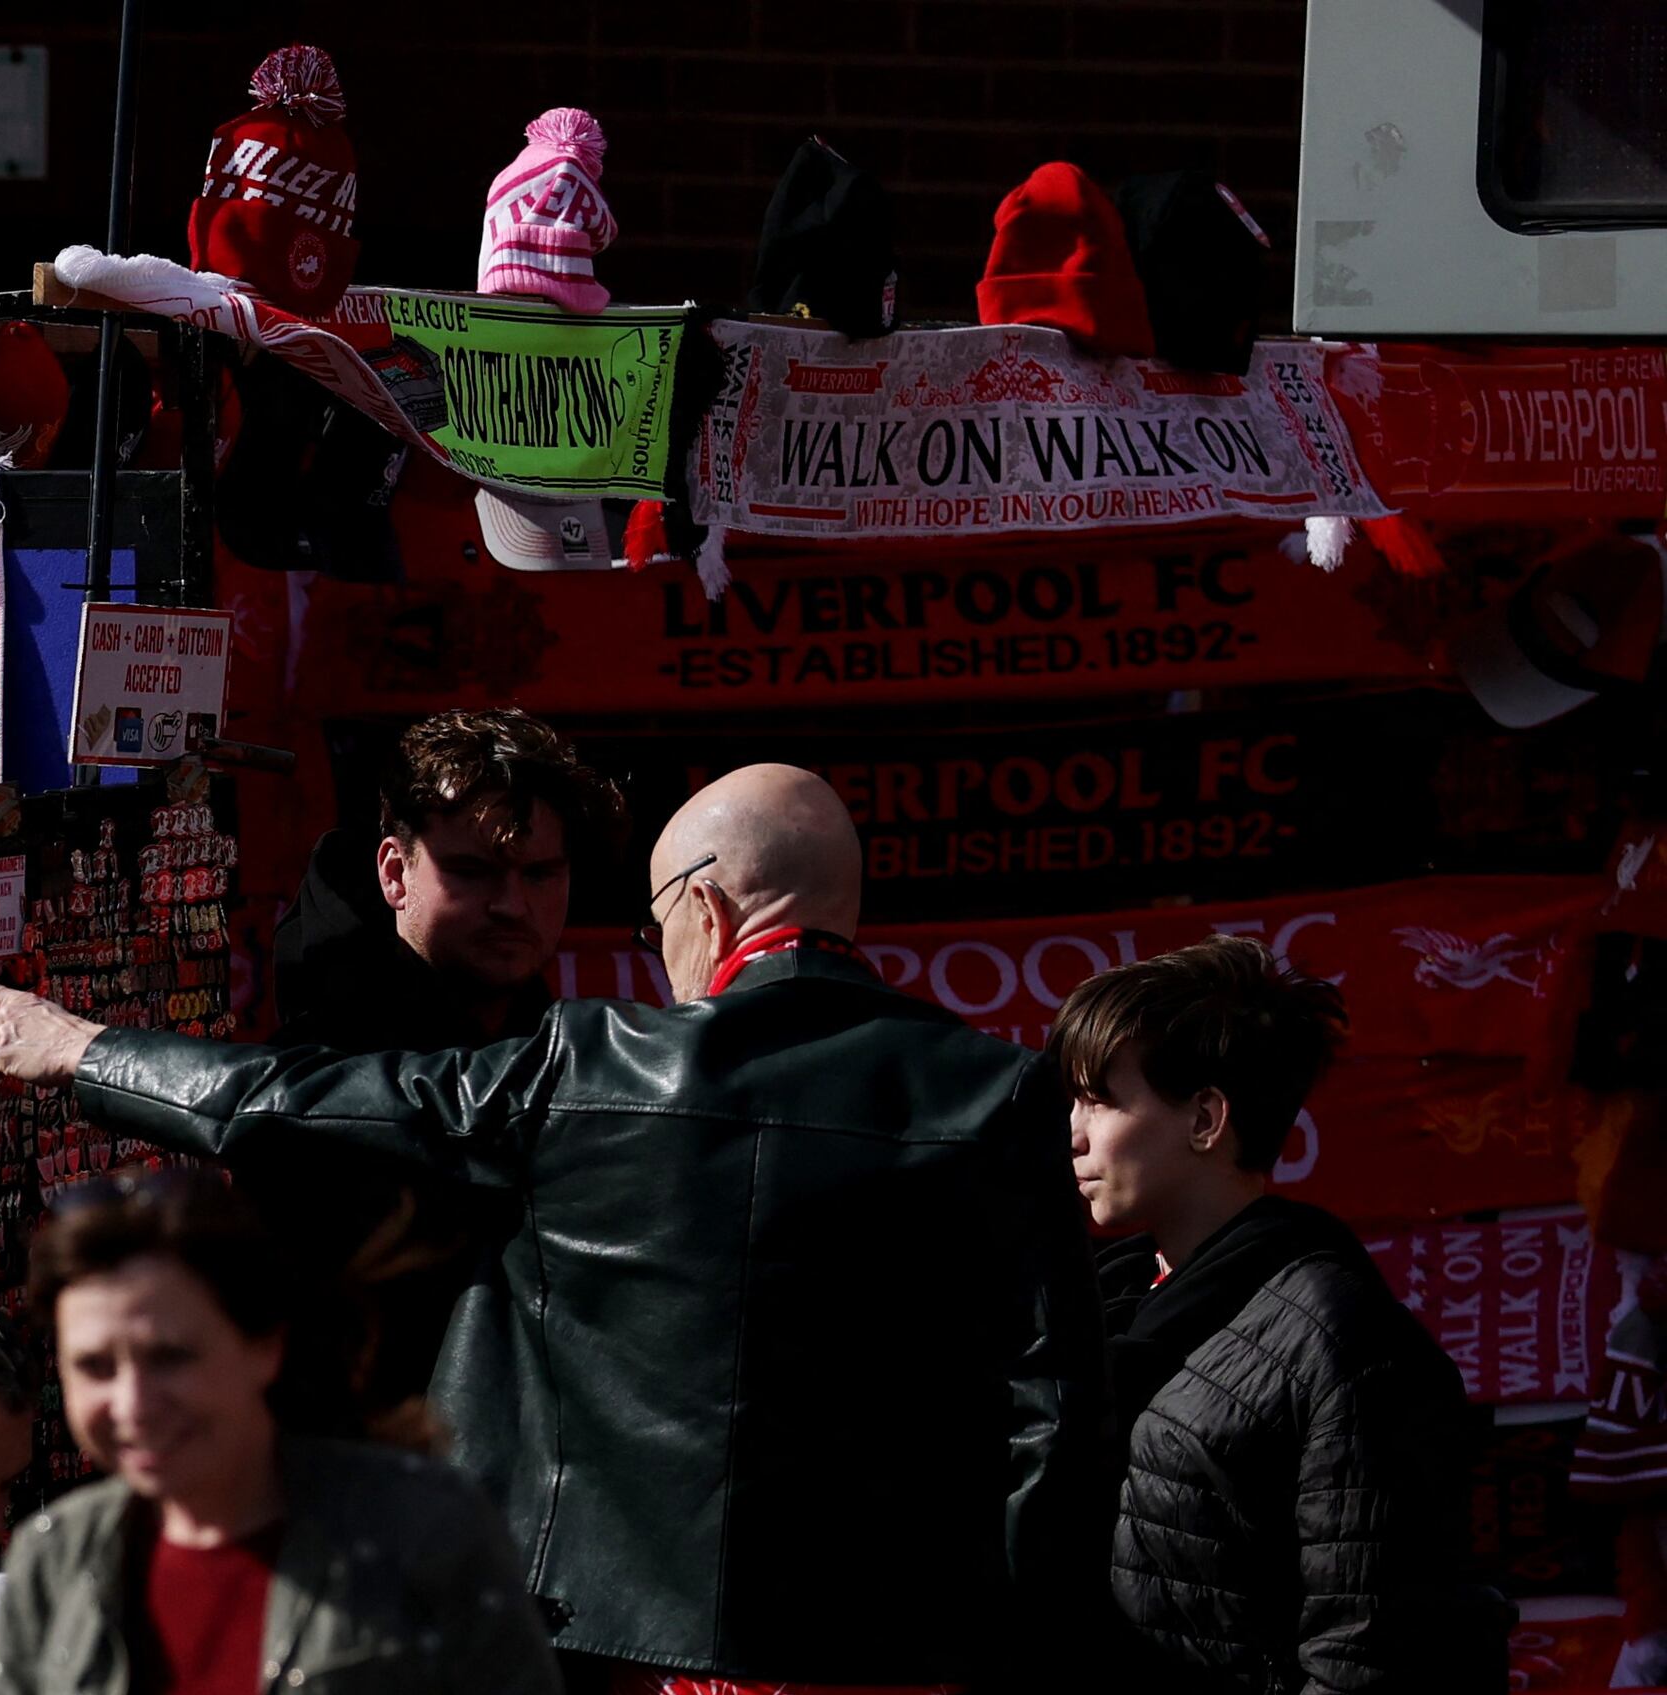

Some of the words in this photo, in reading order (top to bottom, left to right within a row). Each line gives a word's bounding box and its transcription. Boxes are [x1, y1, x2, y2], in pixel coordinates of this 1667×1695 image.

[221, 138, 333, 199] ALLEZ
[386, 296, 469, 334] LEAGUE
[444, 345, 615, 451] SOUTHAMPTON
[799, 370, 869, 391] LIVERPOOL
[1479, 386, 1658, 463] LIVERPOOL
[782, 420, 906, 487] WALK
[918, 417, 1001, 486] ON
[1024, 416, 1198, 482] WALK
[1195, 417, 1270, 476] ON
[855, 498, 909, 527] WITH
[916, 497, 990, 527] HOPE
[1000, 493, 1031, 523] IN
[1038, 489, 1126, 522] YOUR
[1133, 484, 1218, 516] HEART
[662, 562, 1122, 639] LIVERPOOL
[1151, 549, 1256, 613] FC
[92, 623, 121, 651] CASH
[134, 625, 164, 653] CARD
[178, 627, 223, 656] BITCOIN
[124, 664, 181, 694] ACCEPTED
[123, 728, 139, 741] VISA
[1500, 1226, 1544, 1278] ON
[1498, 1287, 1541, 1397] WALK
